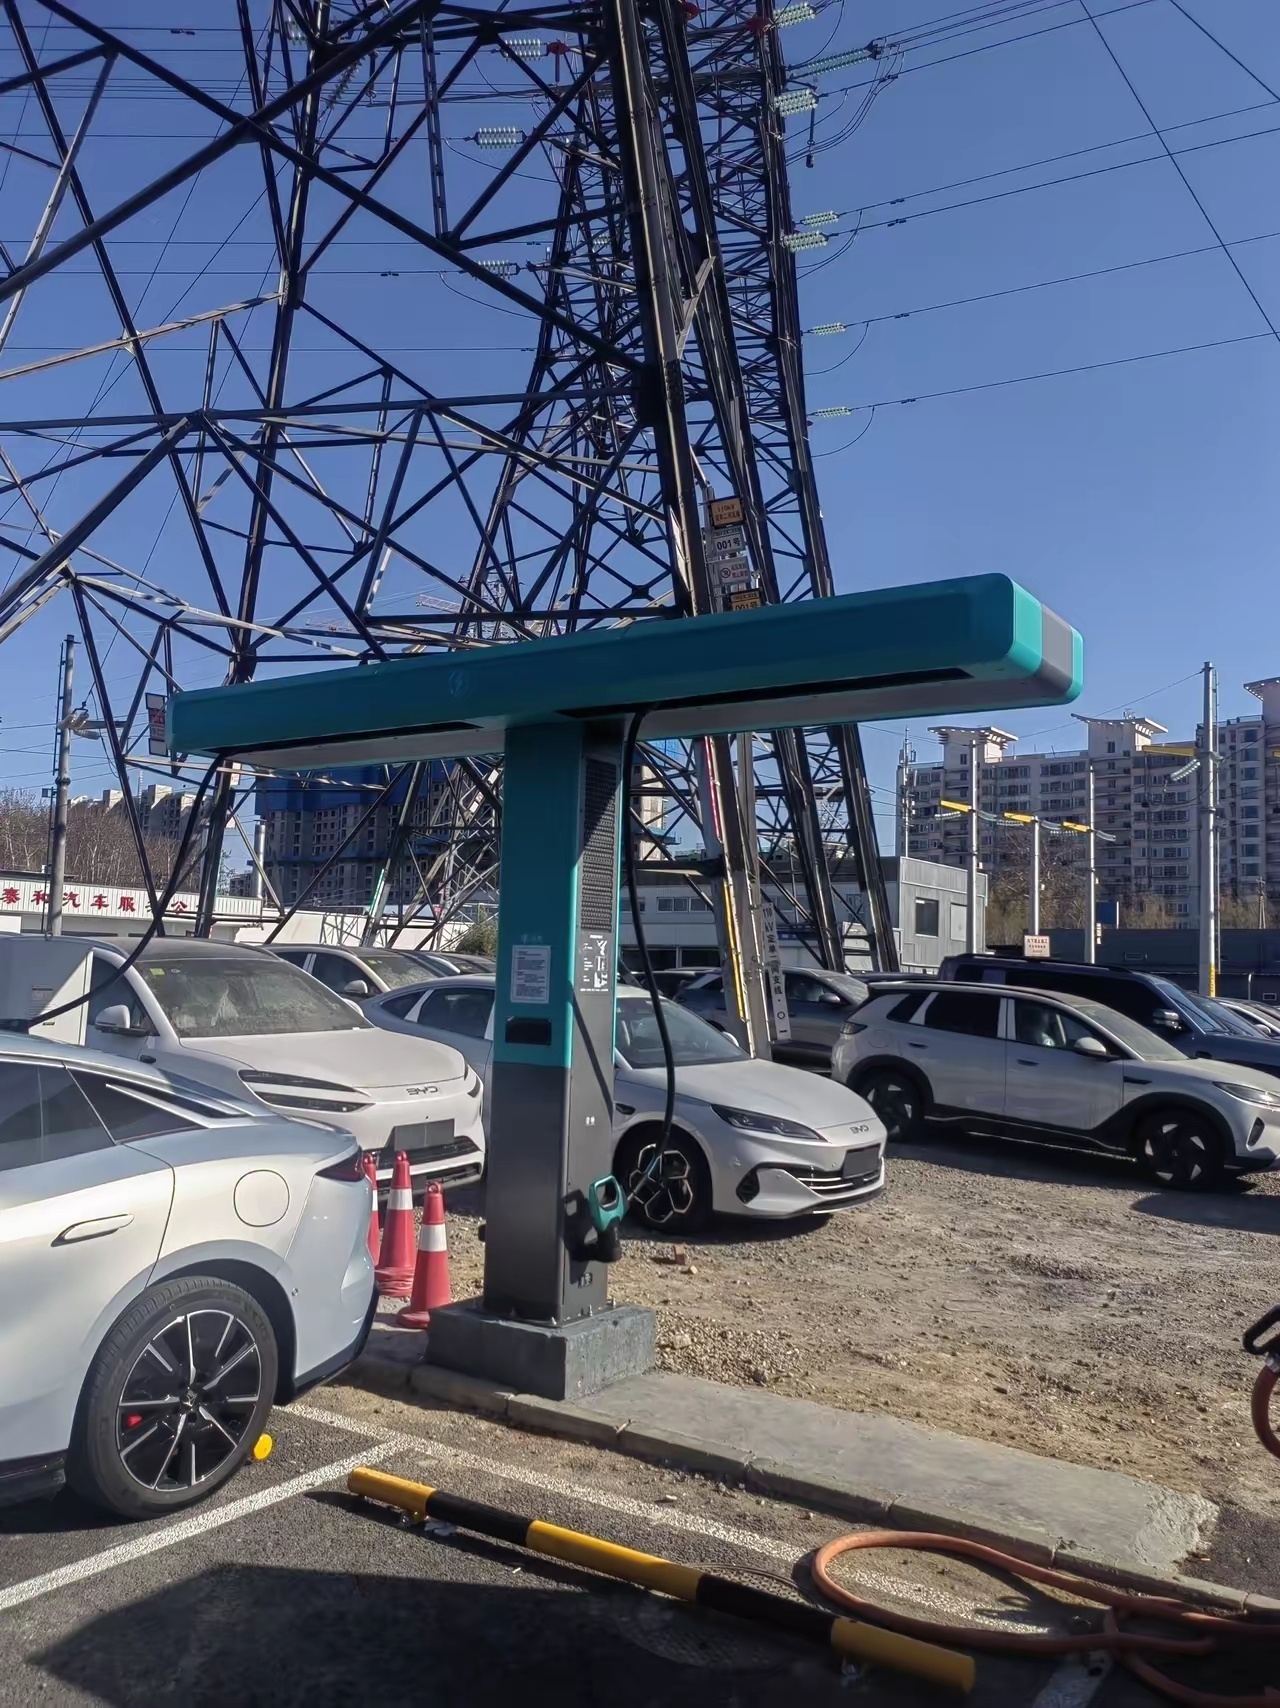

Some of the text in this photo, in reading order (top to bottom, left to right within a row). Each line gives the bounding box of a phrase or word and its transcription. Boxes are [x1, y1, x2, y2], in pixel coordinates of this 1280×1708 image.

[716, 537, 741, 551] 001号
[0, 886, 200, 915] 泰和汽车服公
[406, 1086, 438, 1095] BYD
[850, 1124, 869, 1134] BYD
